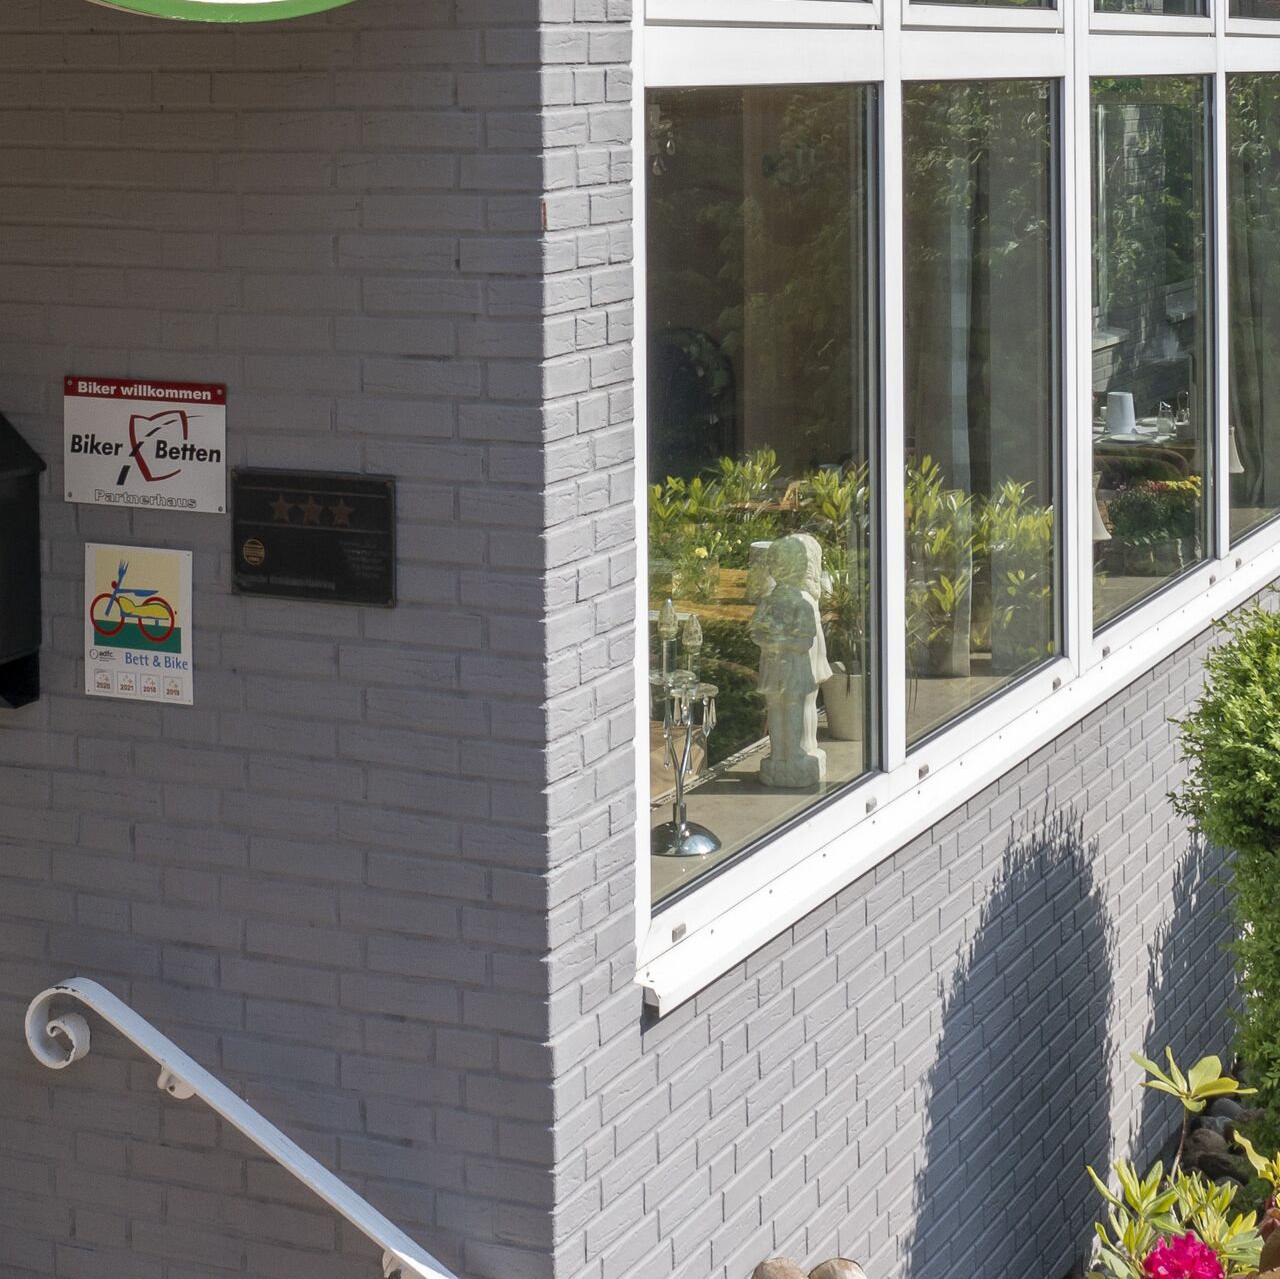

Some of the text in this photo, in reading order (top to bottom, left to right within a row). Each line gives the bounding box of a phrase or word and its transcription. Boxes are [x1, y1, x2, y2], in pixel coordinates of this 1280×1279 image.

[77, 381, 212, 401] Biker willkommen
[70, 434, 222, 463] Biker Betten
[94, 489, 198, 509] Partnerhaus
[125, 651, 189, 671] Bett & Bike
